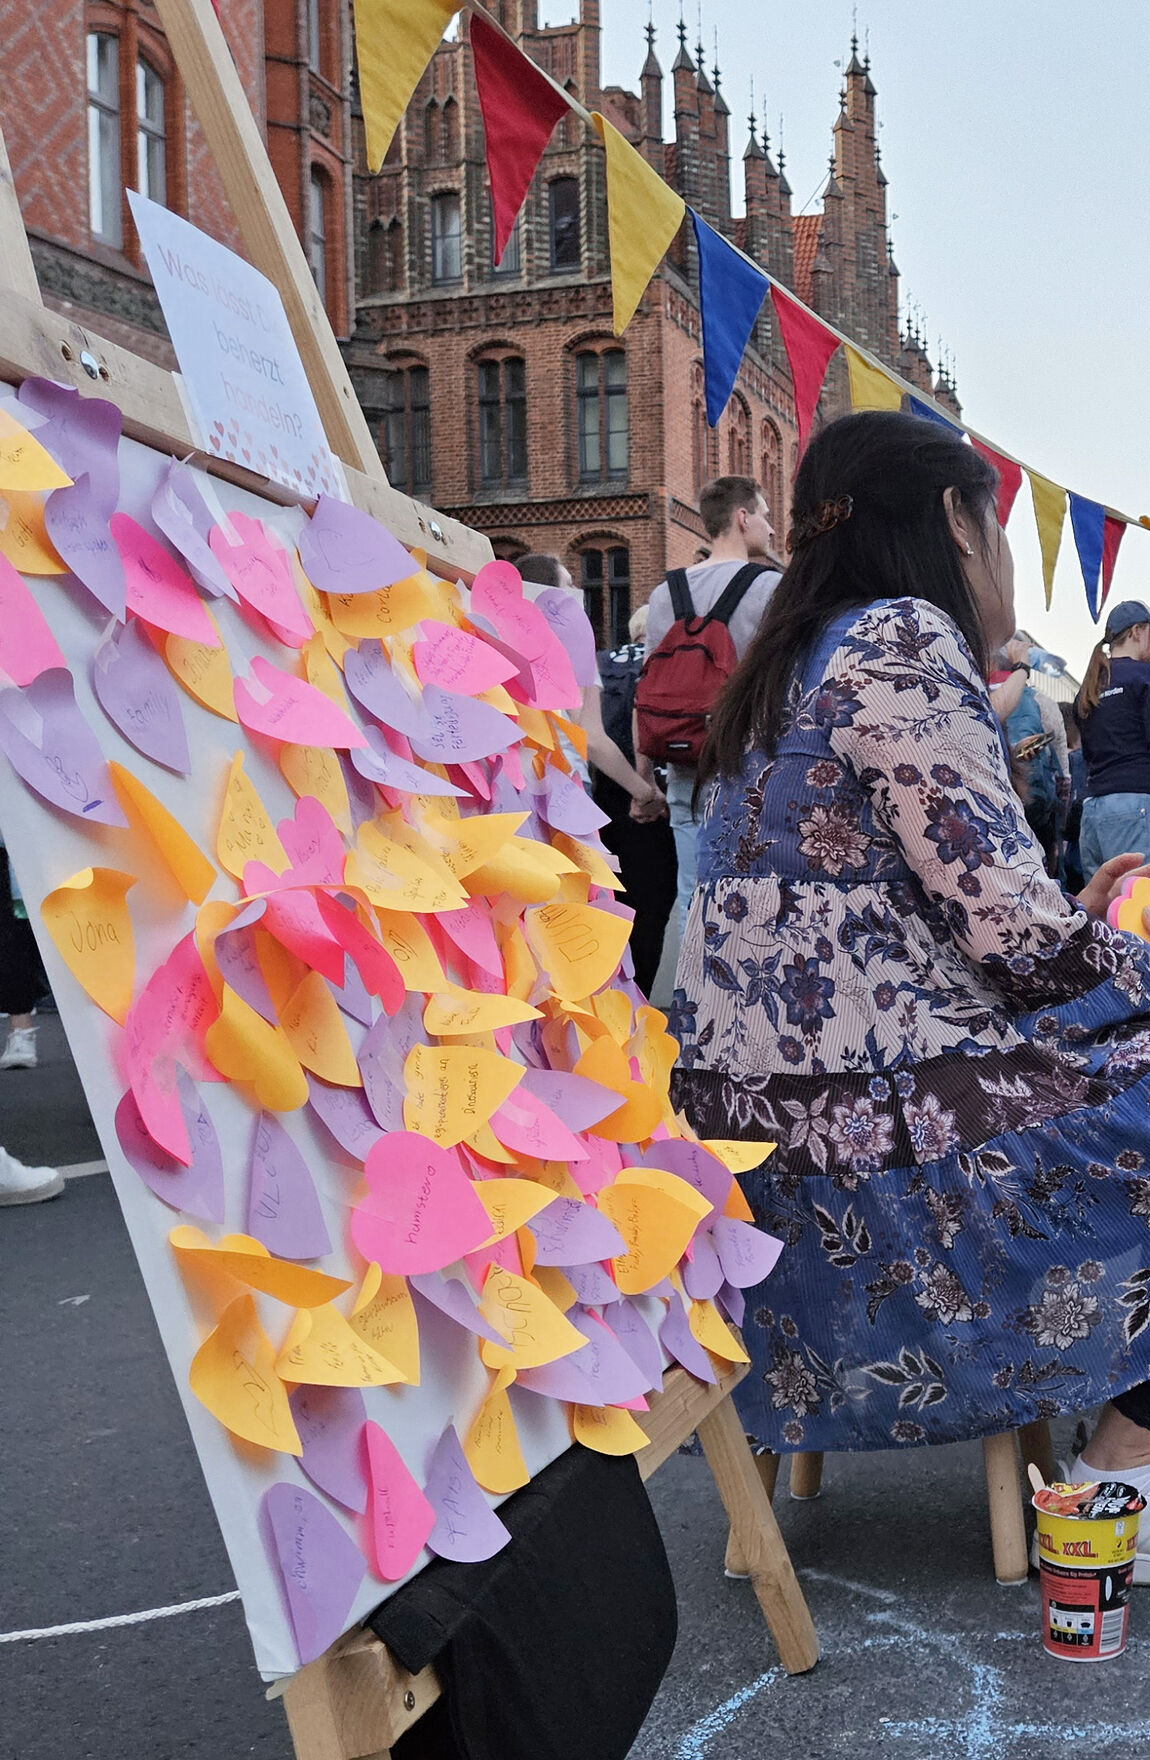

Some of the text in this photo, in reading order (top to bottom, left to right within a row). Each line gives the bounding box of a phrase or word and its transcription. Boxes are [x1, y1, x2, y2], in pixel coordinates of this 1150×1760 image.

[157, 243, 209, 297] Was
[212, 320, 285, 386] beherzt
[220, 371, 303, 440] handeln?
[1062, 1540, 1099, 1558] XXL
